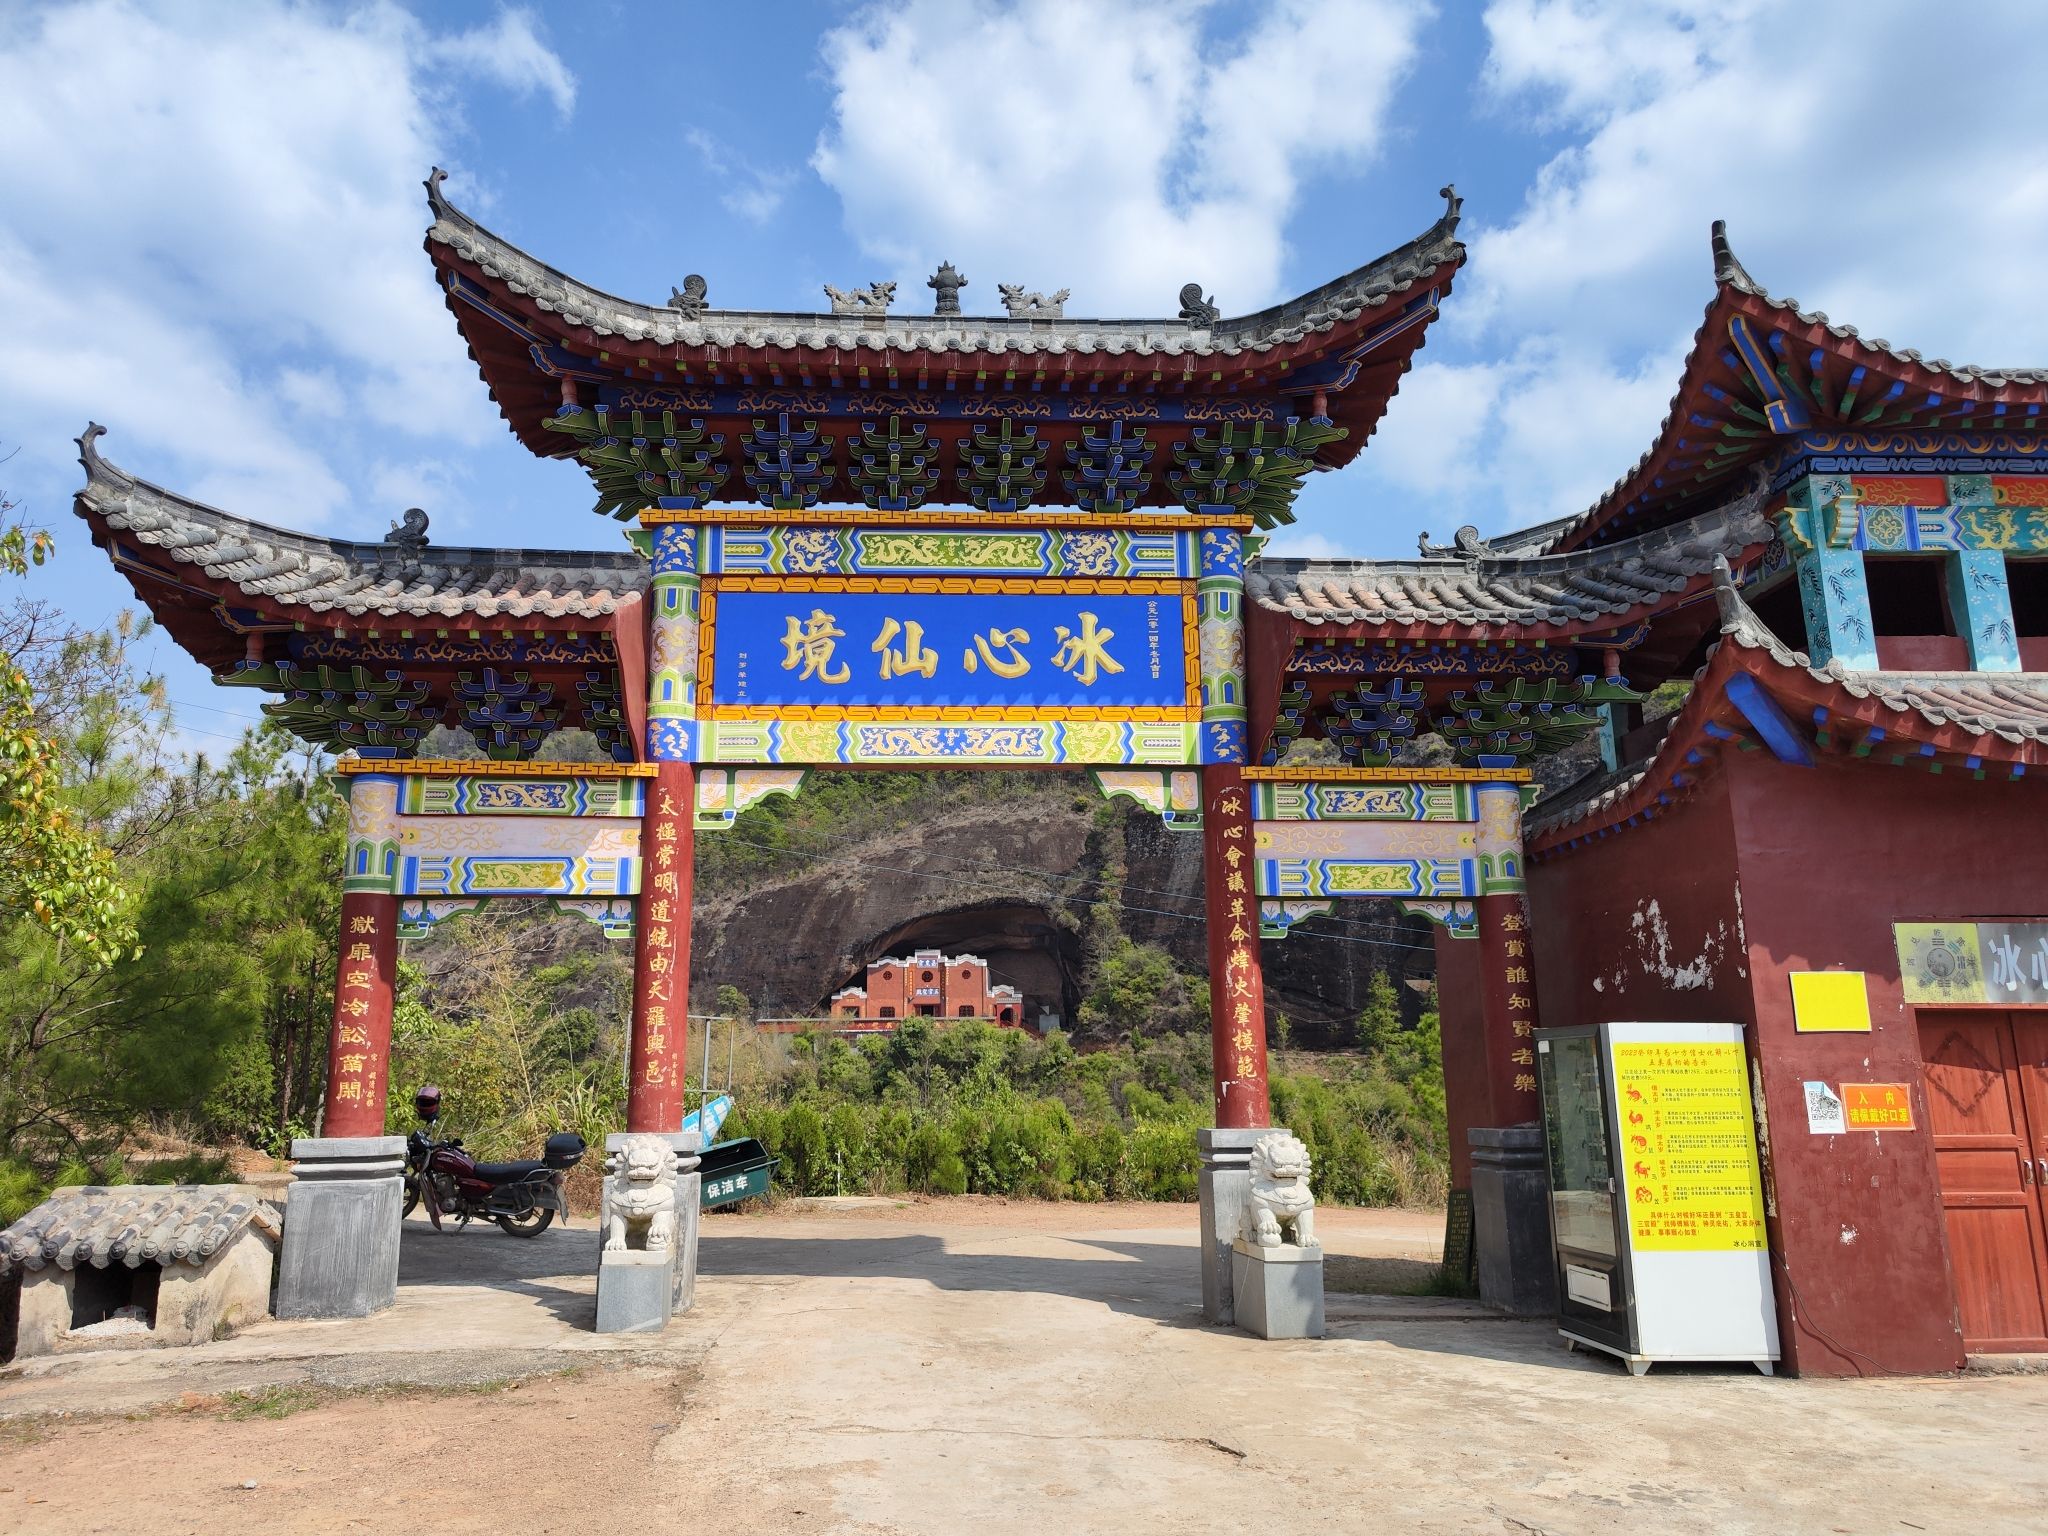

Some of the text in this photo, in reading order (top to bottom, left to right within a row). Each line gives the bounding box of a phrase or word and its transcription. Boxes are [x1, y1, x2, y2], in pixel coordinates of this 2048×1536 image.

[1849, 1108, 1909, 1123] 请佩戴好口罩
[707, 1175, 749, 1199] 保洁车
